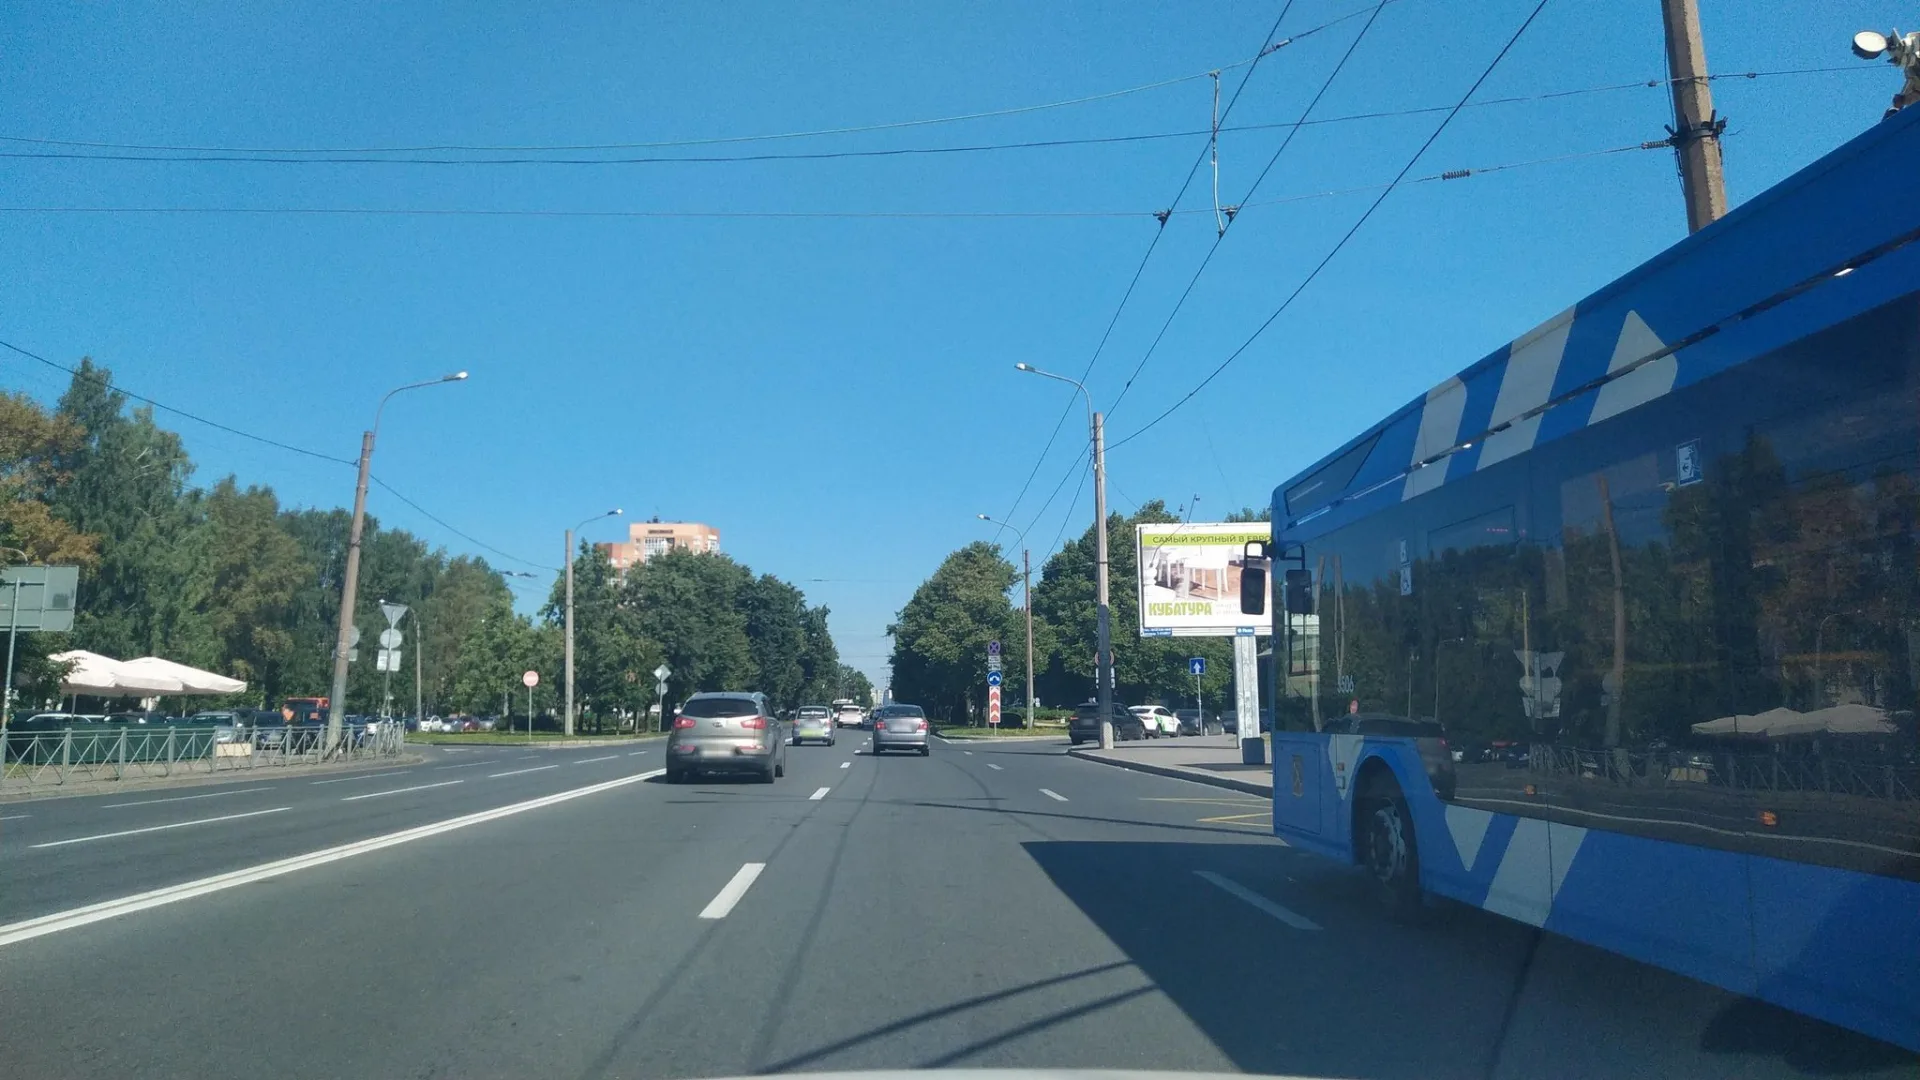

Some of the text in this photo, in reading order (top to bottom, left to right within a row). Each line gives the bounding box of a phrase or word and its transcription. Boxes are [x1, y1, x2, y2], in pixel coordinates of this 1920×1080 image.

[1152, 535, 1188, 544] САМЫЙ
[1190, 534, 1236, 543] КРУПНЫЙ
[1238, 535, 1245, 543] В
[1149, 602, 1213, 616] КУБАТУРА
